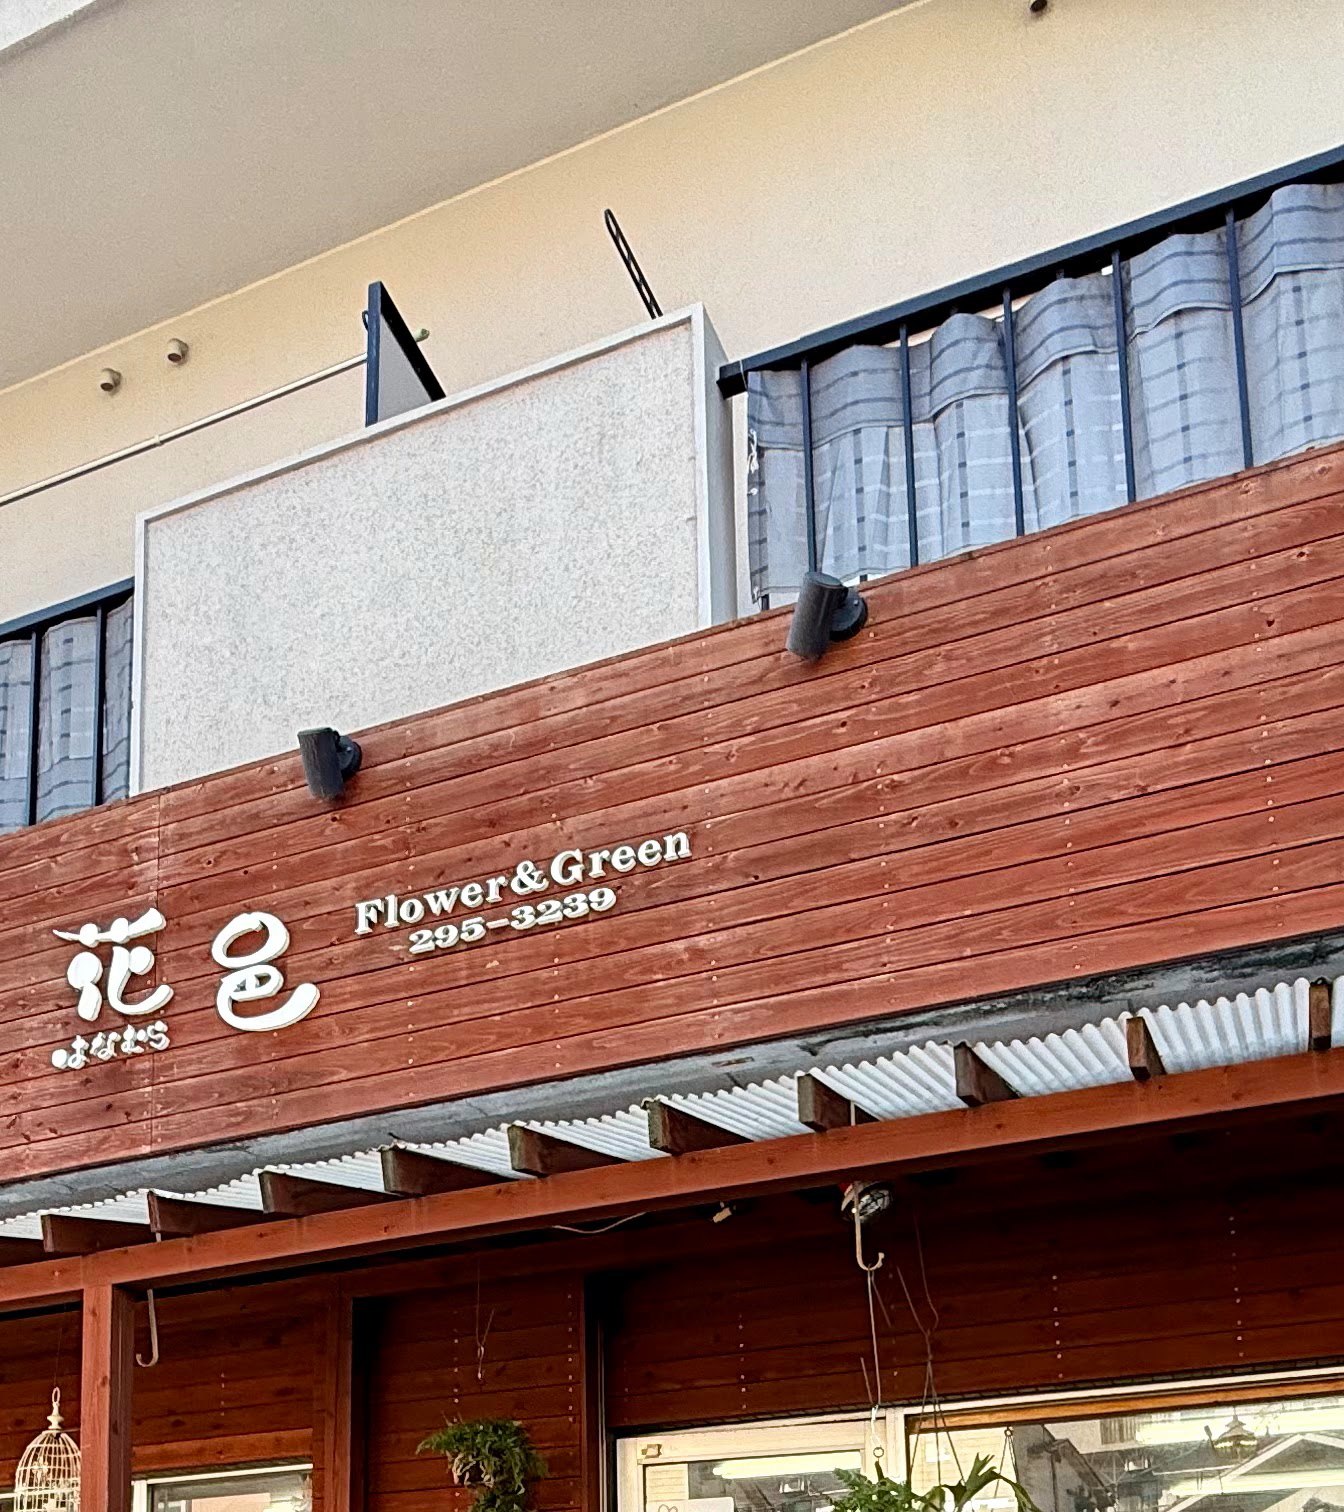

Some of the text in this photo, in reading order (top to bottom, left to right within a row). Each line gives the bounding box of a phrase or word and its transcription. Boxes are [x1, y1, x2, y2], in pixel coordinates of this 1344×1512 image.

[356, 831, 692, 935] Flower&Green
[409, 887, 617, 954] 295-3239
[52, 1020, 170, 1069] はなむら
